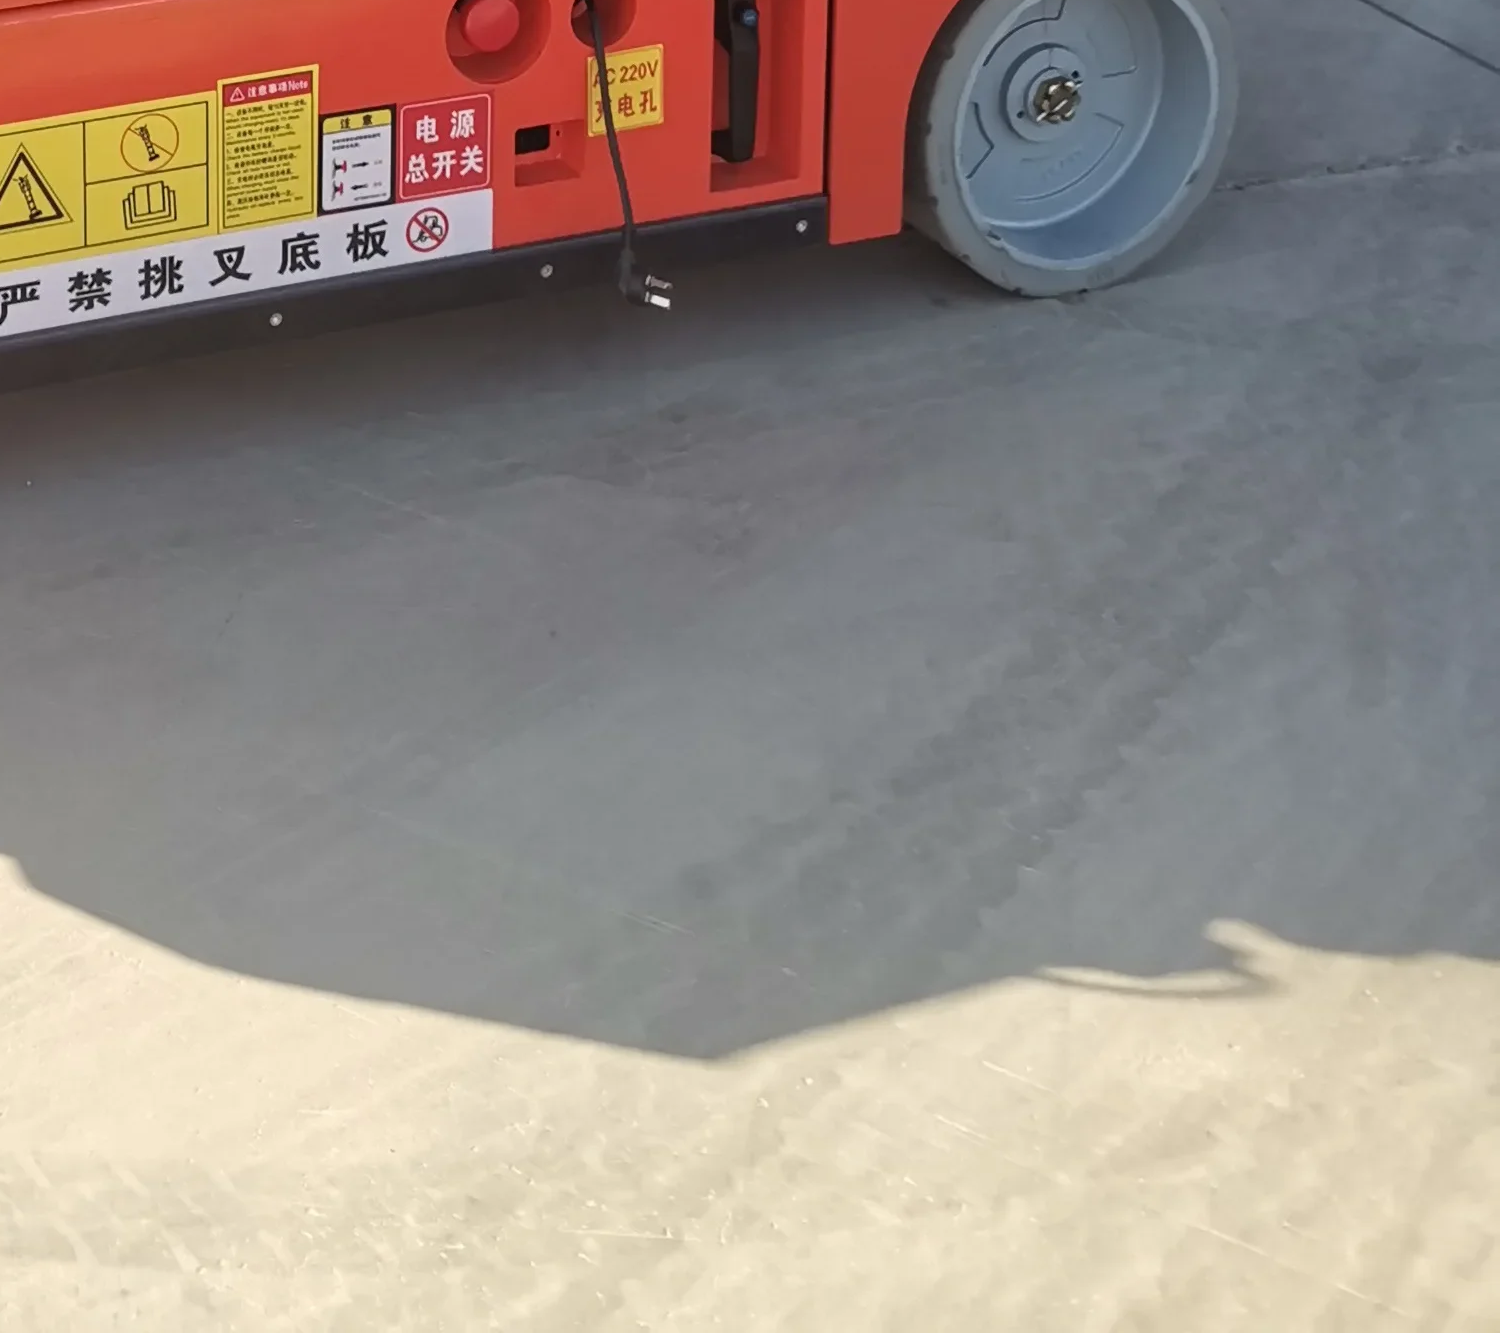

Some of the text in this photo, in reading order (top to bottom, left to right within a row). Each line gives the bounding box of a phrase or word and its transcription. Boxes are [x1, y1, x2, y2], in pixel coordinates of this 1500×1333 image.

[620, 59, 659, 84] 220V
[416, 108, 476, 144] 电源
[404, 145, 485, 184] 总开关
